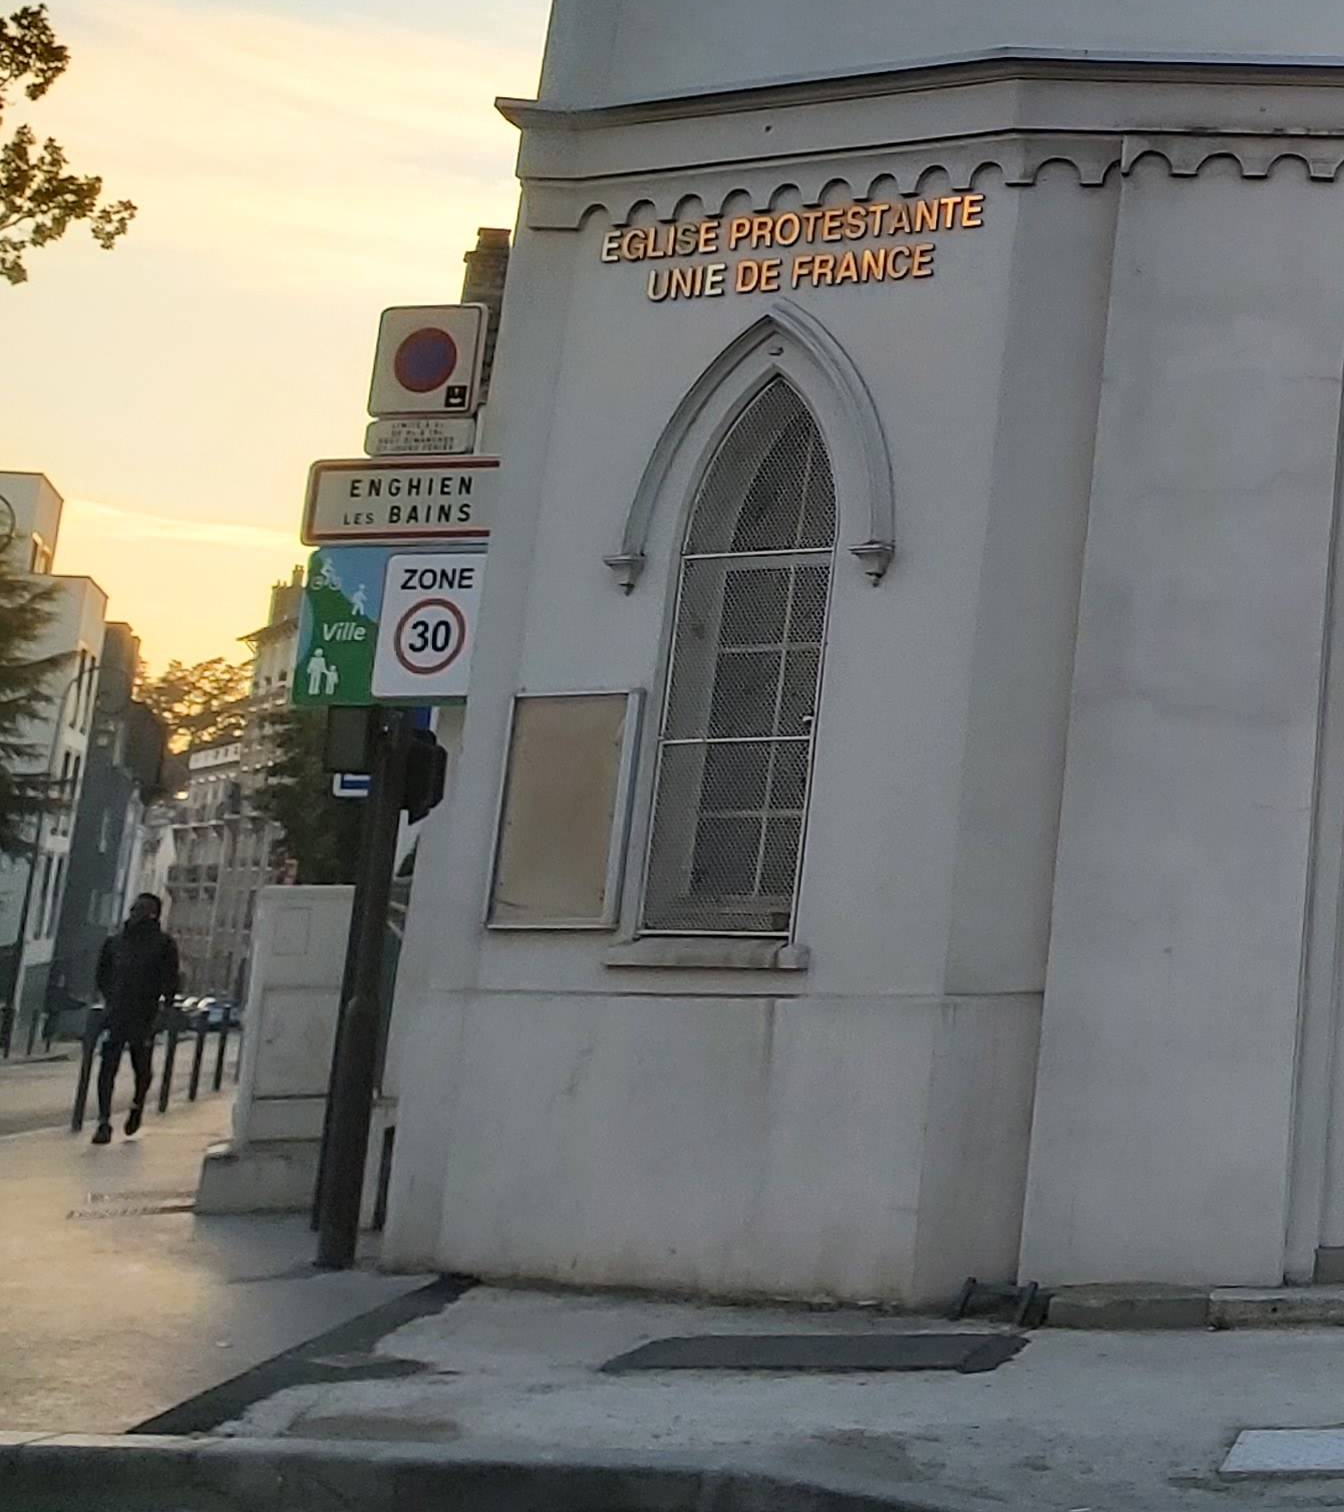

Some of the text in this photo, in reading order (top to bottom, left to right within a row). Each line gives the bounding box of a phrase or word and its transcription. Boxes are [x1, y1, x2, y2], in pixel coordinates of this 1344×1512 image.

[728, 193, 986, 251] PROTESTANTE
[646, 243, 936, 302] UNIE DE FRANCE
[350, 476, 473, 498] ENGHIEN
[343, 503, 472, 525] LES BAINS
[400, 568, 475, 590] ZONE
[323, 622, 367, 641] Ville
[408, 620, 452, 653] 30
